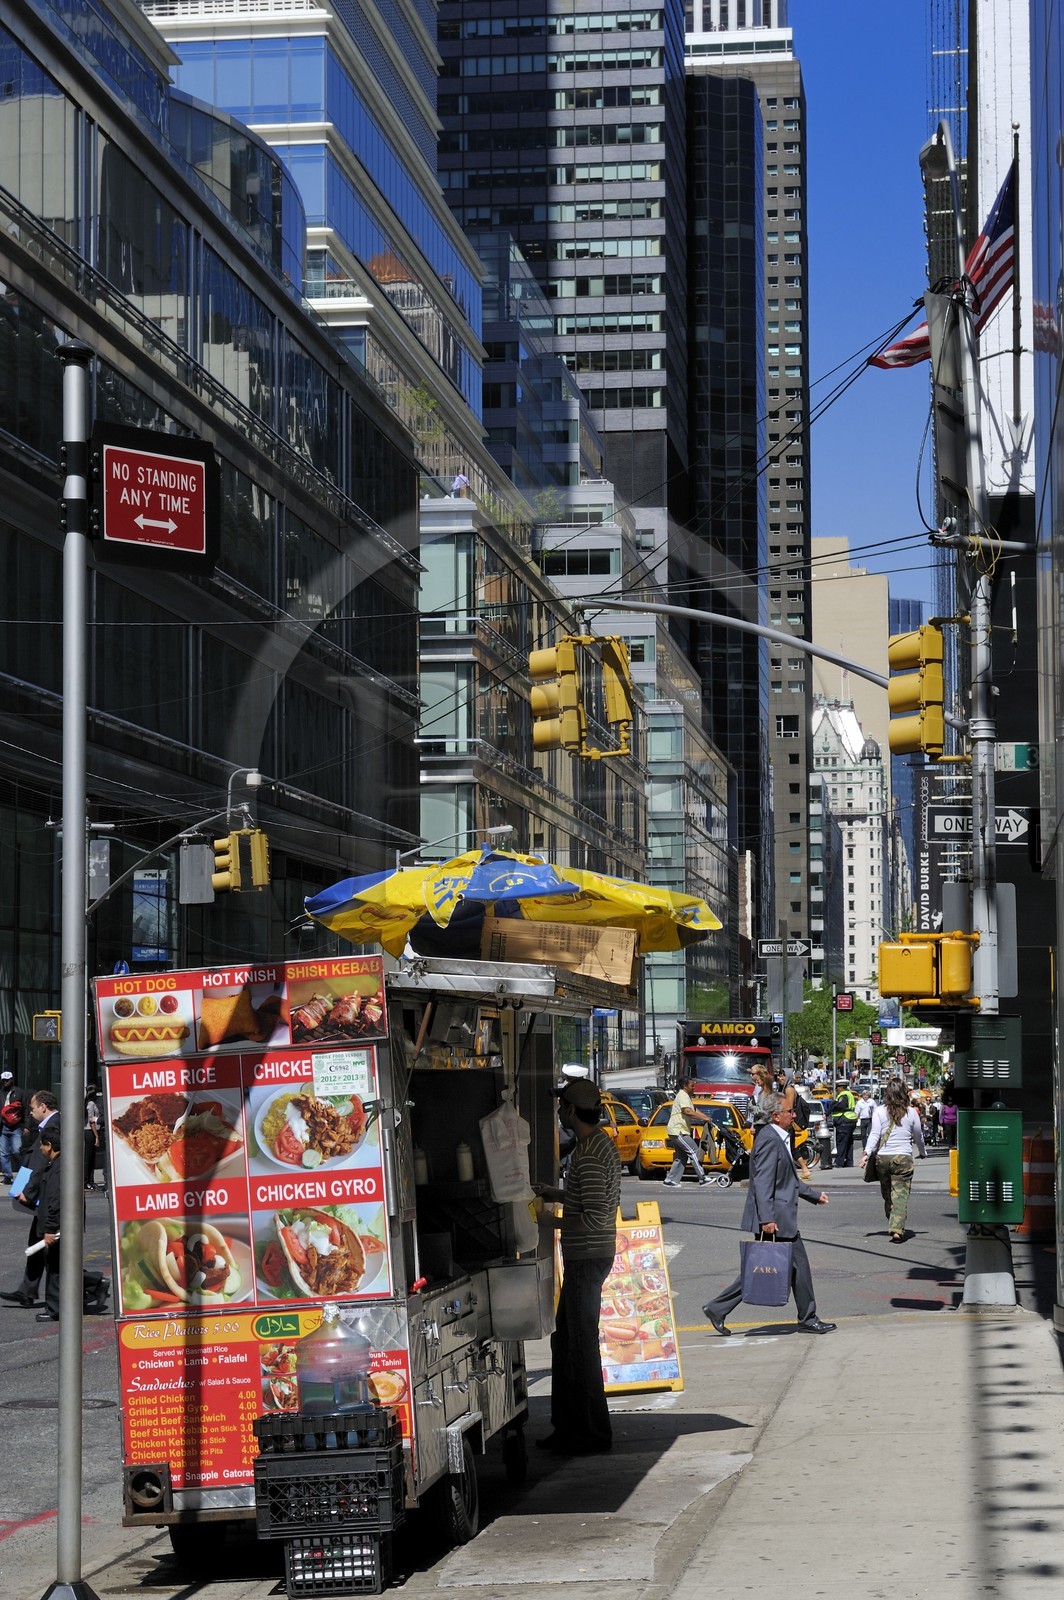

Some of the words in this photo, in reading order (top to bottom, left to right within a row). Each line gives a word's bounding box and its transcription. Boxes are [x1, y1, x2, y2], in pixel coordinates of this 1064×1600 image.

[112, 462, 130, 480] NO
[138, 466, 197, 492] STANDING
[120, 488, 152, 508] ANY
[158, 493, 190, 514] TIME
[943, 818, 973, 831] ONE
[920, 852, 930, 890] BURKE
[921, 894, 930, 930] DAVID
[202, 973, 230, 986] HOT
[234, 969, 276, 983] KNISH
[287, 964, 327, 979] SHISH
[332, 960, 379, 976] KEBAB
[114, 981, 142, 994] HOT
[146, 978, 176, 991] DOG
[701, 1024, 756, 1034] KAMCO
[133, 1070, 176, 1089] LAMB
[180, 1067, 216, 1085] RICE
[253, 1060, 312, 1080] CHICKE
[256, 1182, 326, 1203] CHICKEN
[331, 1178, 376, 1198] GYRO
[136, 1192, 179, 1212] LAMB
[184, 1188, 228, 1208] GYRO
[631, 1229, 656, 1239] FOOD
[134, 1324, 159, 1339] Rice
[163, 1322, 209, 1340] Platters
[213, 1322, 239, 1335] 5.00
[260, 1318, 296, 1335] حلال
[186, 1347, 212, 1355] Basmatti
[138, 1360, 174, 1369] Chicken
[184, 1357, 209, 1366] Lamb
[218, 1354, 248, 1364] Falafel
[127, 1377, 195, 1392] Sandwiches
[128, 1396, 157, 1406] Grilled
[160, 1394, 195, 1403] Chicken
[238, 1390, 256, 1399] 4.00
[129, 1407, 158, 1416] Grilled
[160, 1405, 184, 1414] Lamb
[187, 1404, 208, 1414] Gyro
[239, 1402, 257, 1410] 4.00
[130, 1418, 158, 1428] Grilled
[161, 1416, 181, 1426] Beef
[184, 1413, 226, 1423] Sandwich
[240, 1412, 257, 1420] 4.00
[130, 1429, 150, 1438] Beef
[152, 1427, 177, 1436] Shish
[180, 1425, 208, 1435] Kebab
[240, 1423, 253, 1432] 3.0
[131, 1439, 166, 1449] Chicken
[169, 1437, 196, 1446] Kebab
[131, 1450, 167, 1460] Chicken
[169, 1448, 197, 1458] Kebab
[242, 1445, 259, 1453] 4.00
[170, 1459, 187, 1468] bab
[186, 1470, 218, 1480] Snapple
